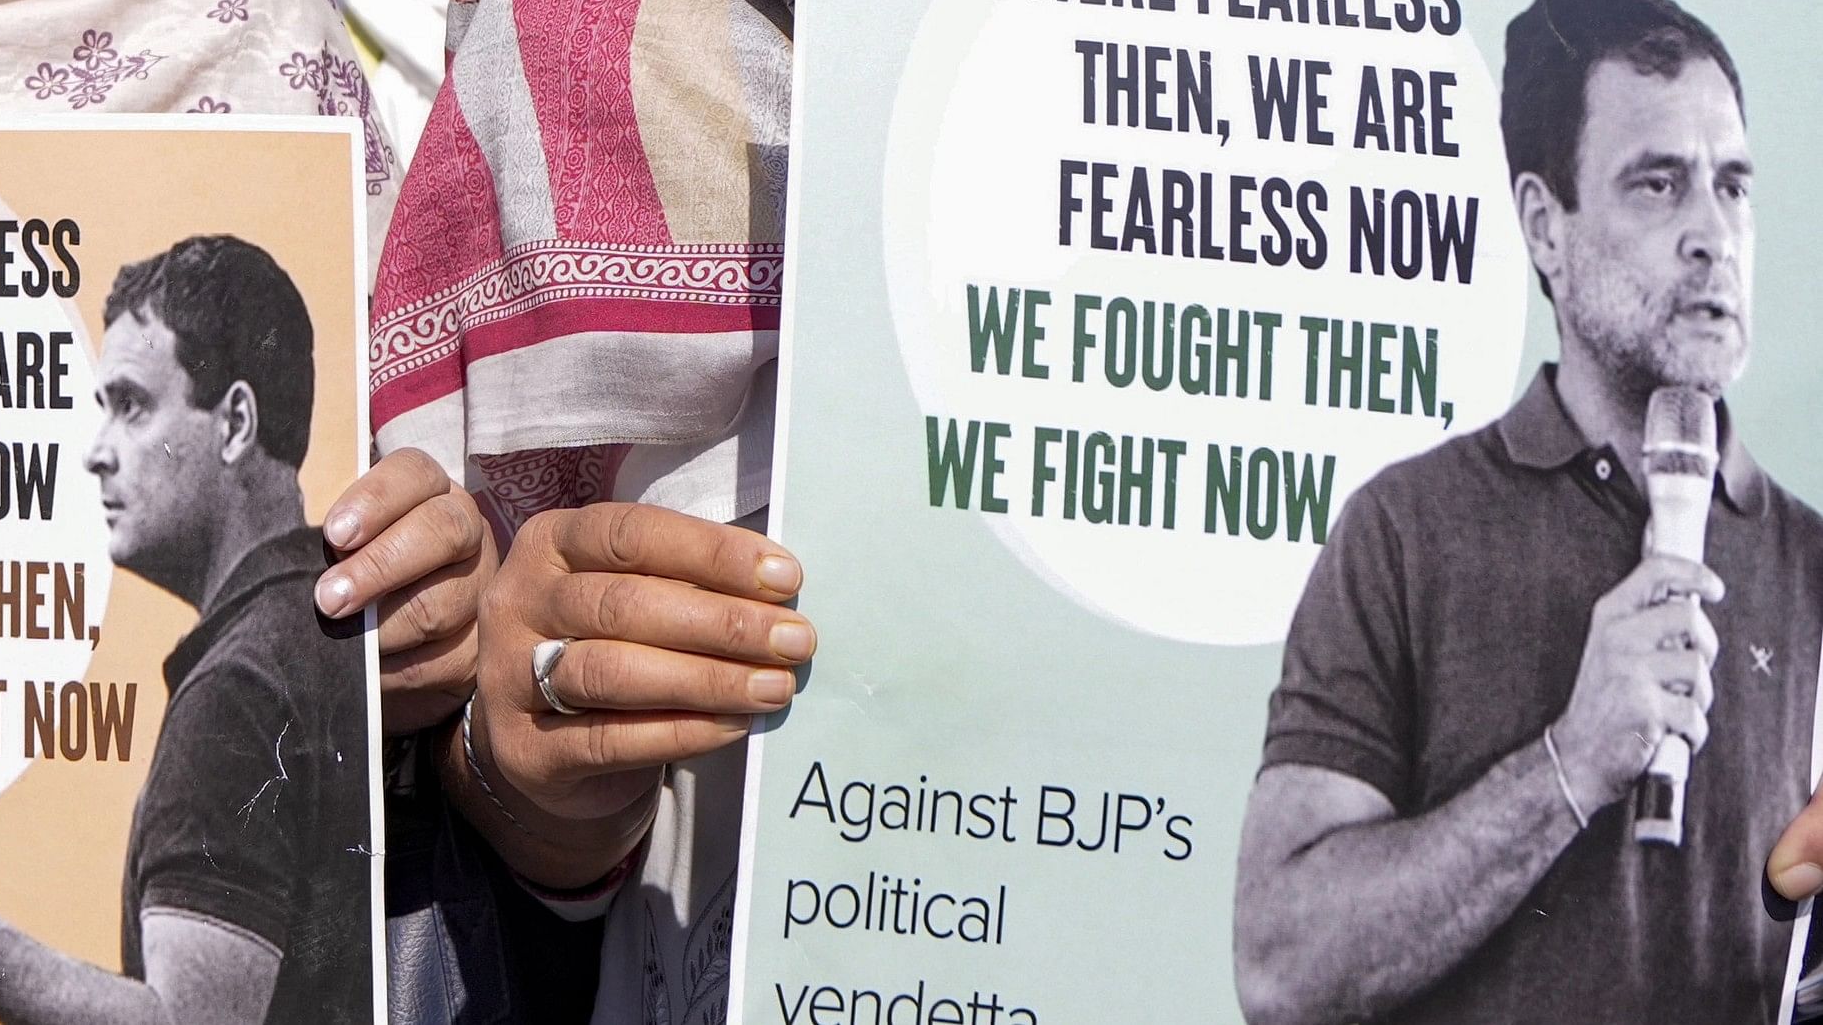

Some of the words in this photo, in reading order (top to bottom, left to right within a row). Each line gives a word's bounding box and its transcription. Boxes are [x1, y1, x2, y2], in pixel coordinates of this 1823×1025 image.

[1075, 40, 1229, 147] THEN,
[1248, 55, 1333, 146] WE
[1354, 66, 1459, 157] ARE
[1059, 160, 1327, 270] FEARLESS
[1350, 186, 1479, 284] NOW
[967, 284, 1051, 379] WE
[1072, 294, 1282, 401] FOUGHT
[1300, 316, 1453, 430] THEN,
[926, 416, 1011, 513] WE
[1032, 427, 1186, 530] FIGHT
[1205, 444, 1336, 545] NOW
[25, 681, 137, 761] NOW
[790, 762, 1017, 842] Against
[1037, 786, 1192, 860] BJP’s
[784, 872, 1005, 944] political
